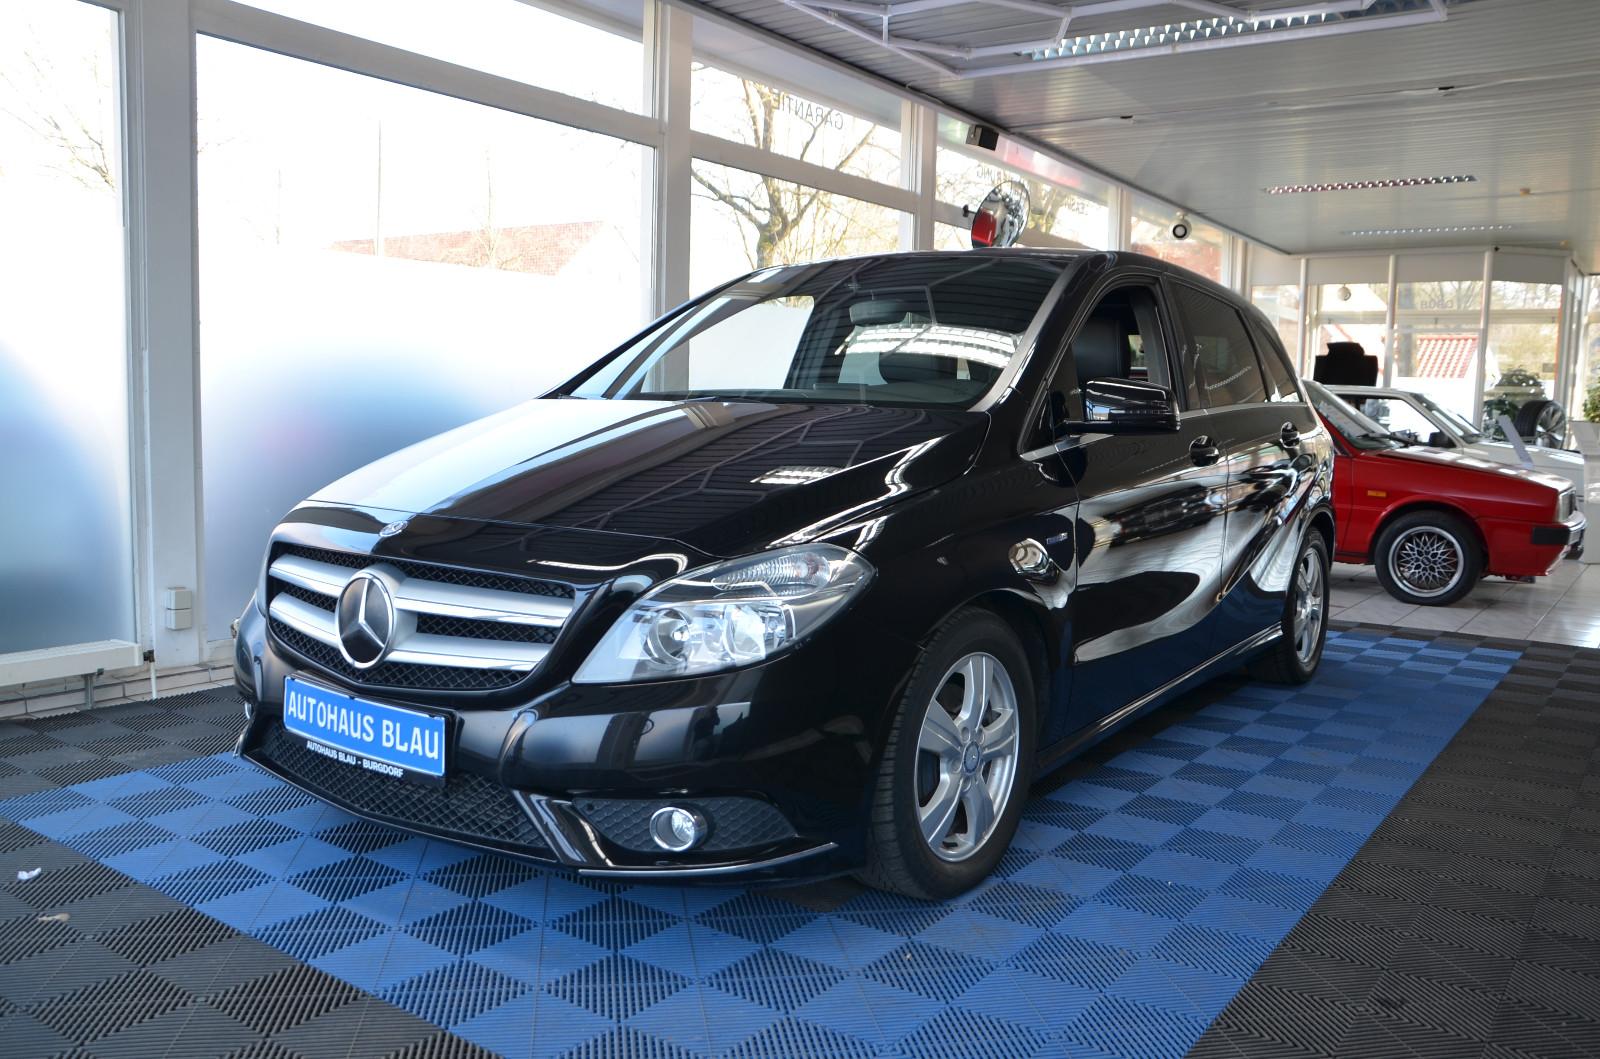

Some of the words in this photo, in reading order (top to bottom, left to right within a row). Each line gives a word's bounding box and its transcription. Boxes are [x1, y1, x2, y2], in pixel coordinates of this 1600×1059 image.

[288, 691, 374, 742] AUTOHAUS
[382, 719, 439, 760] BLAU
[306, 741, 337, 760] AUTOHAUS
[338, 752, 356, 765] BLAU
[362, 759, 404, 778] BURGDORF
